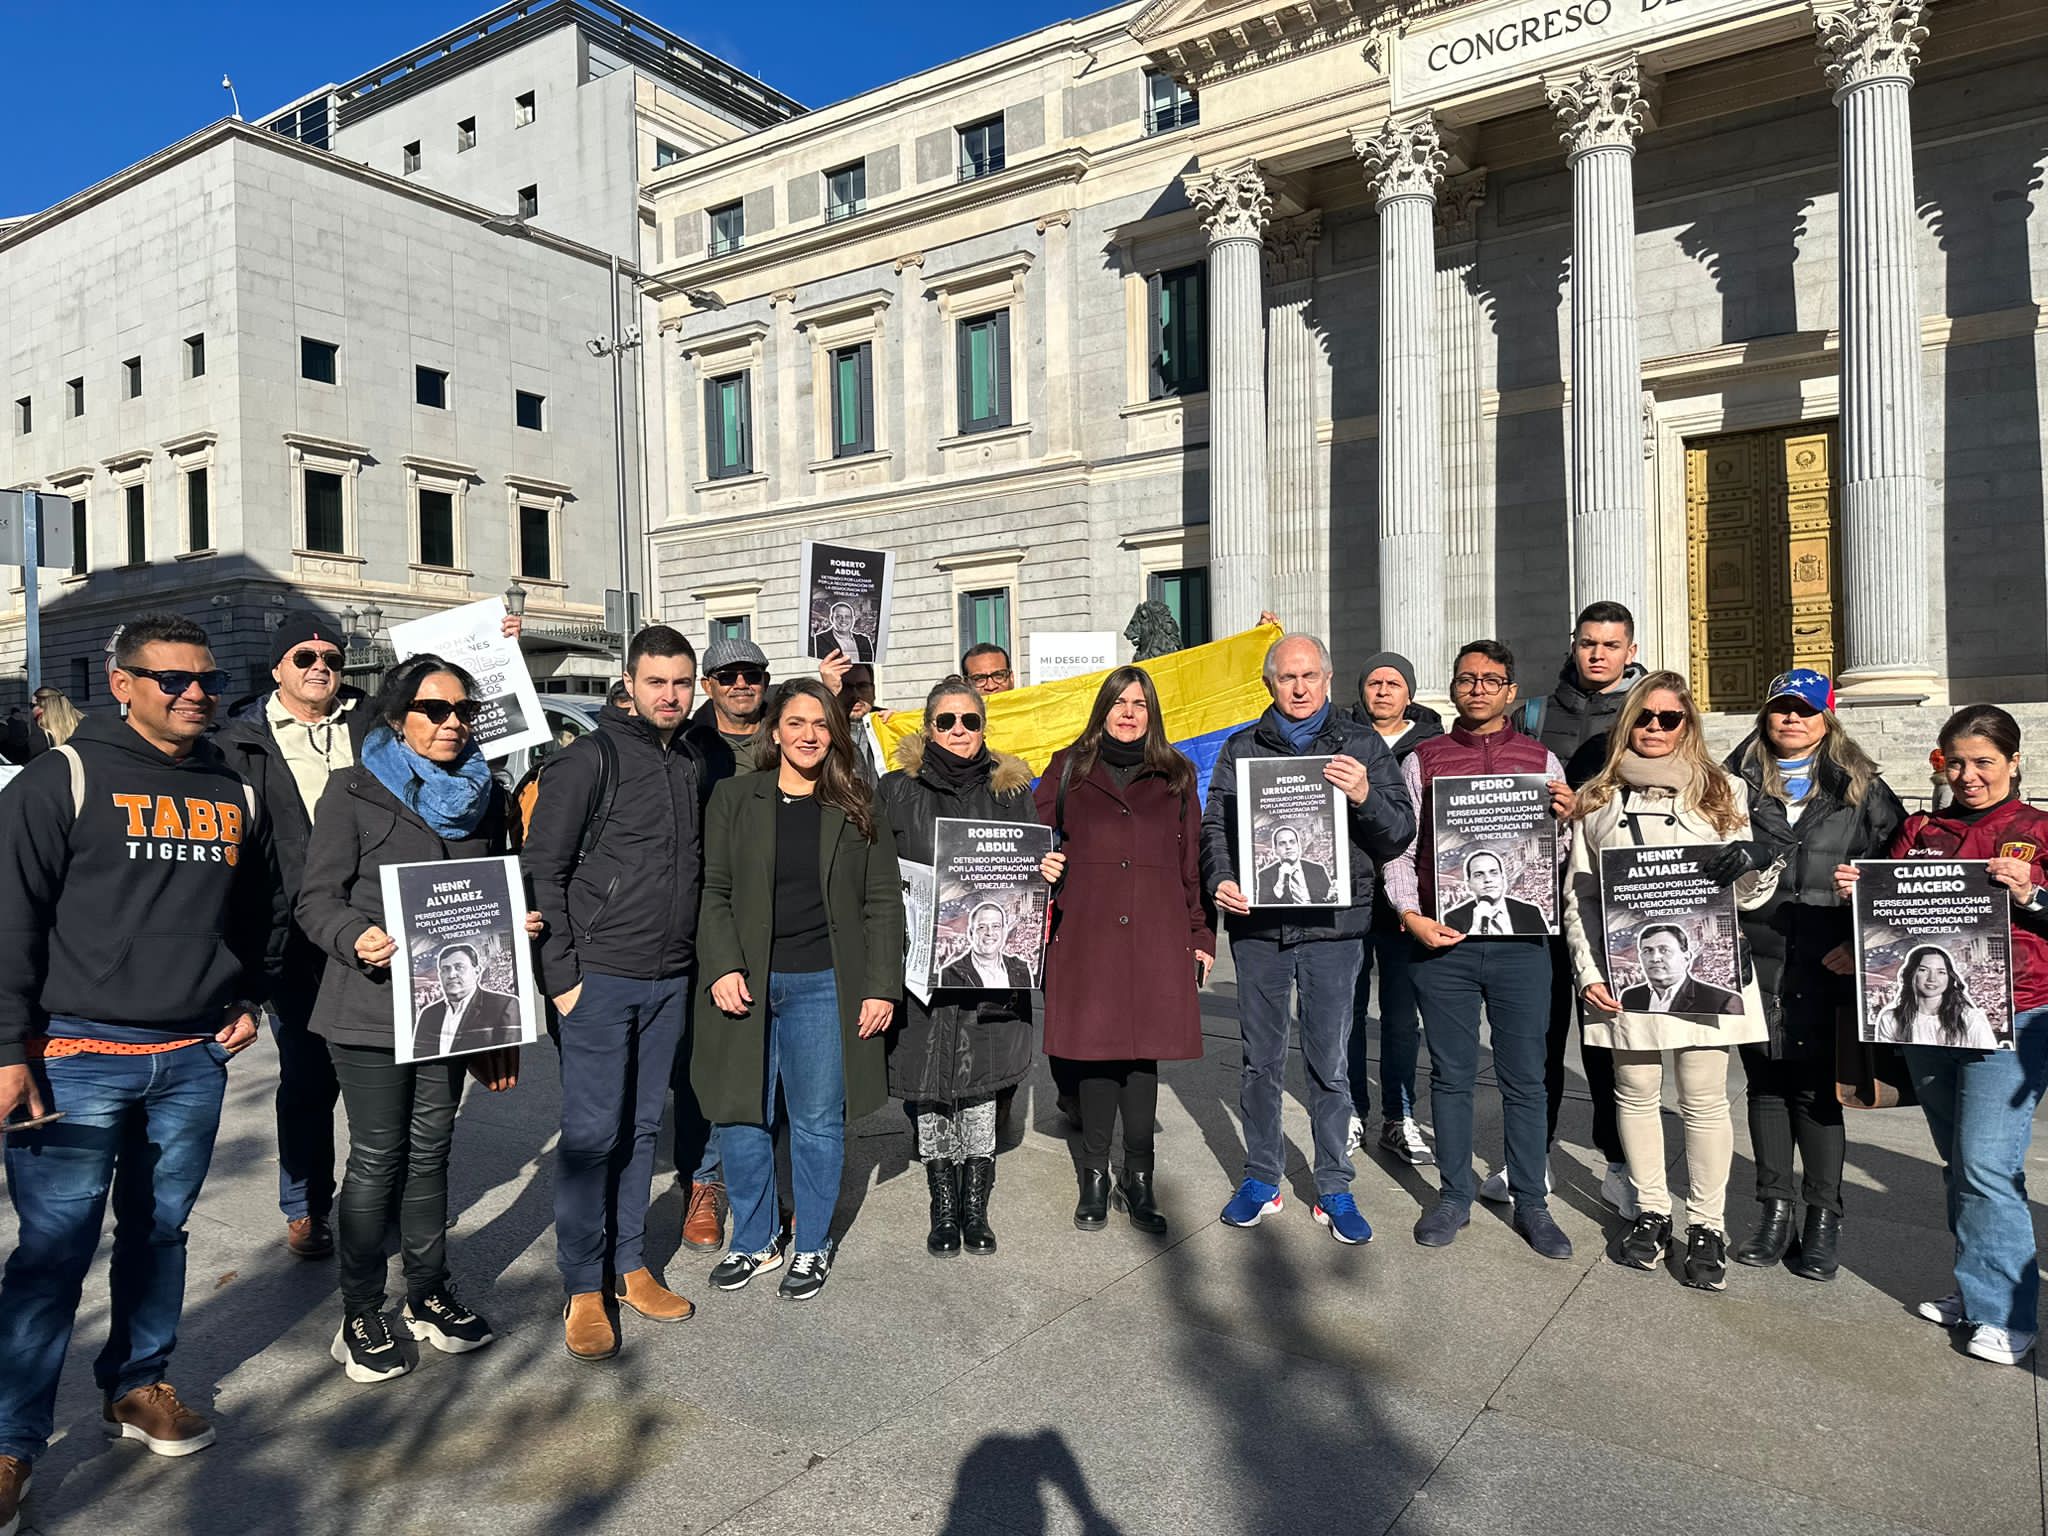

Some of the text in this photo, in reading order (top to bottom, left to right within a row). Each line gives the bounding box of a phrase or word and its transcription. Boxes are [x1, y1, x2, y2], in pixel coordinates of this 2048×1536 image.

[1428, 0, 1611, 71] CONGRESO
[830, 559, 866, 569] ROBERTO
[834, 567, 861, 576] ABDUL
[1040, 655, 1105, 664] MI DESEO DE
[479, 716, 508, 730] PRESOS
[1276, 775, 1306, 784] PEDRO
[1471, 778, 1514, 791] PEDRO
[1262, 783, 1322, 795] URRUCHURTU
[1450, 790, 1538, 805] URRUCHURTU
[1447, 808, 1494, 817] PERSEGUIDO
[1512, 805, 1543, 813] LUCHAR
[112, 793, 242, 844] TABB
[1475, 814, 1532, 824] RECUPERACIÓN
[968, 828, 1023, 838] ROBERTO
[1471, 824, 1520, 832] DEMOCRACIA
[1475, 832, 1518, 840] VENEZUELA
[126, 842, 222, 861] TIGERS
[976, 842, 1017, 852] ABDUL
[1637, 848, 1684, 863] HENRY
[975, 864, 1028, 872] RECUPERACIÓN
[1628, 862, 1699, 878] ALVIAREZ
[1893, 865, 1965, 878] CLAUDIA
[433, 880, 471, 893] HENRY
[1614, 882, 1664, 892] PERSEGUIDO
[1897, 880, 1965, 893] MACERO
[427, 890, 483, 907] ALVIAREZ
[1644, 889, 1706, 899] RECUPERACIÓN
[1640, 898, 1694, 908] DEMOCRACIA
[1873, 899, 1930, 907] PERSEGUIDA
[1952, 896, 1990, 904] LUCHAR
[415, 909, 457, 920] PERSEGUIDO
[473, 902, 498, 911] LUCHAR
[1644, 907, 1692, 916] VENEZUELA
[1906, 906, 1977, 915] RECUPERACIÓN
[441, 911, 490, 924] RECUPERACIÓN
[1902, 916, 1963, 924] DEMOCRACIA
[438, 921, 481, 932] DEMOCRACIA
[1907, 926, 1960, 934] VENEZUELA
[442, 929, 480, 939] VENEZUELA
